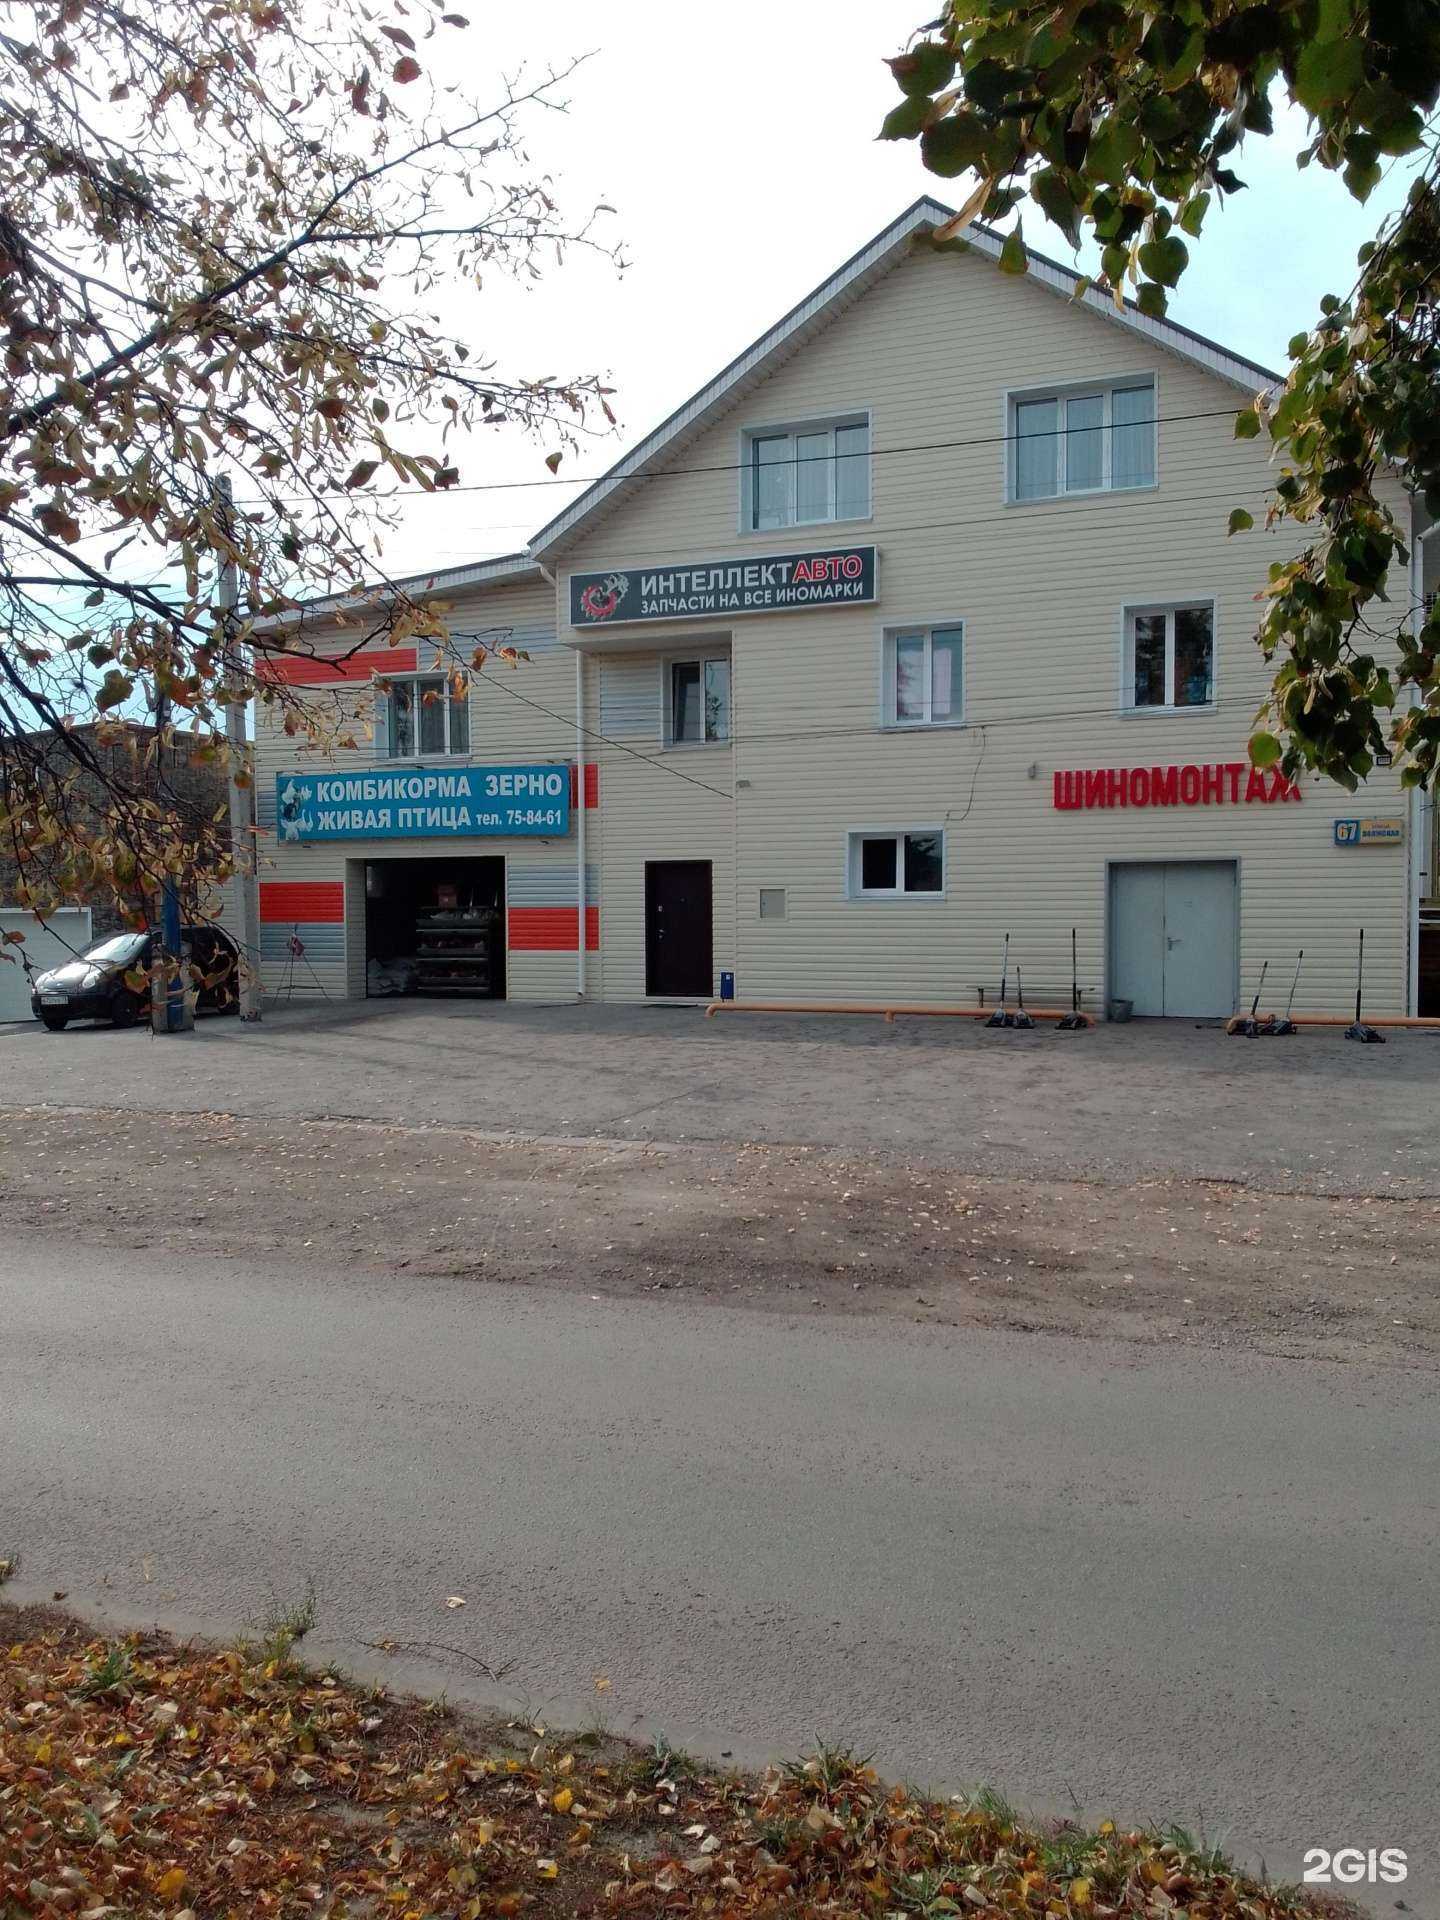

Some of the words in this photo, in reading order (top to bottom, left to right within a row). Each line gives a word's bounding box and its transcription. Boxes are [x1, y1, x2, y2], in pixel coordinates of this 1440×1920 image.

[641, 594, 715, 615] ЗАПЧАСТИ
[719, 592, 740, 608] НА
[744, 588, 772, 606] ВСЕ
[776, 582, 864, 602] ИНОМАРКИ
[317, 775, 472, 802] КОМБИКОРМА
[485, 773, 563, 797] ЗЕРНО
[317, 808, 391, 831] ЖИВАЯ
[398, 806, 471, 830] ПТИЦА
[476, 812, 502, 826] тел.
[506, 809, 562, 826] 75-84-61
[1337, 822, 1357, 841] 67
